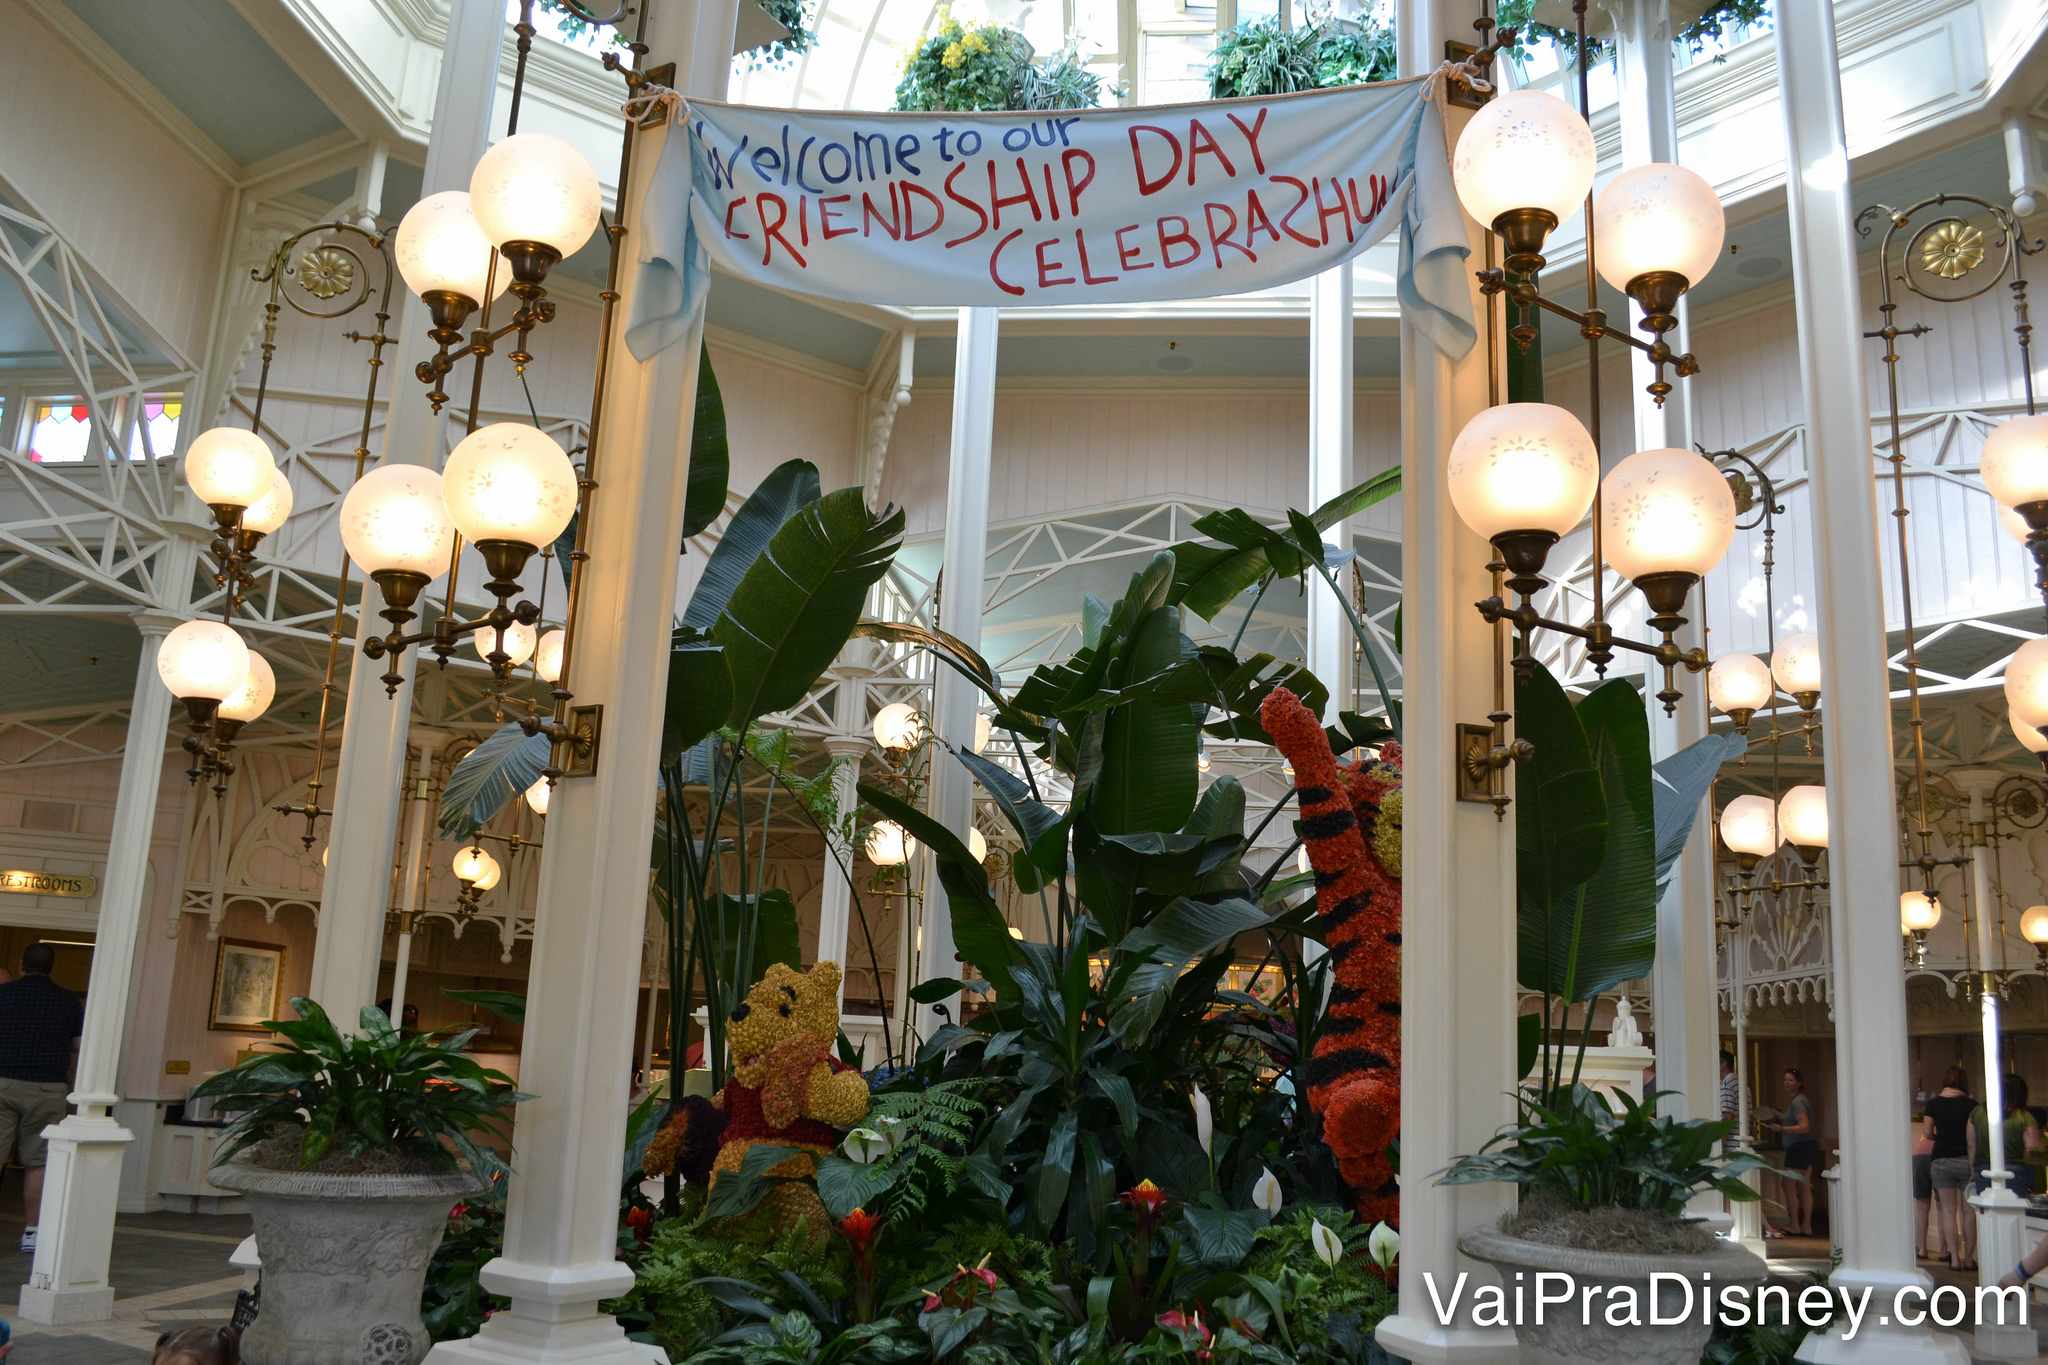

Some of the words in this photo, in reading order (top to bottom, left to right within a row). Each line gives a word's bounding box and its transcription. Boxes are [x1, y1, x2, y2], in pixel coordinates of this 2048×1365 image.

[695, 120, 921, 194] Welcome
[932, 126, 982, 162] to
[1002, 116, 1081, 152] our
[1128, 107, 1268, 197] DAY
